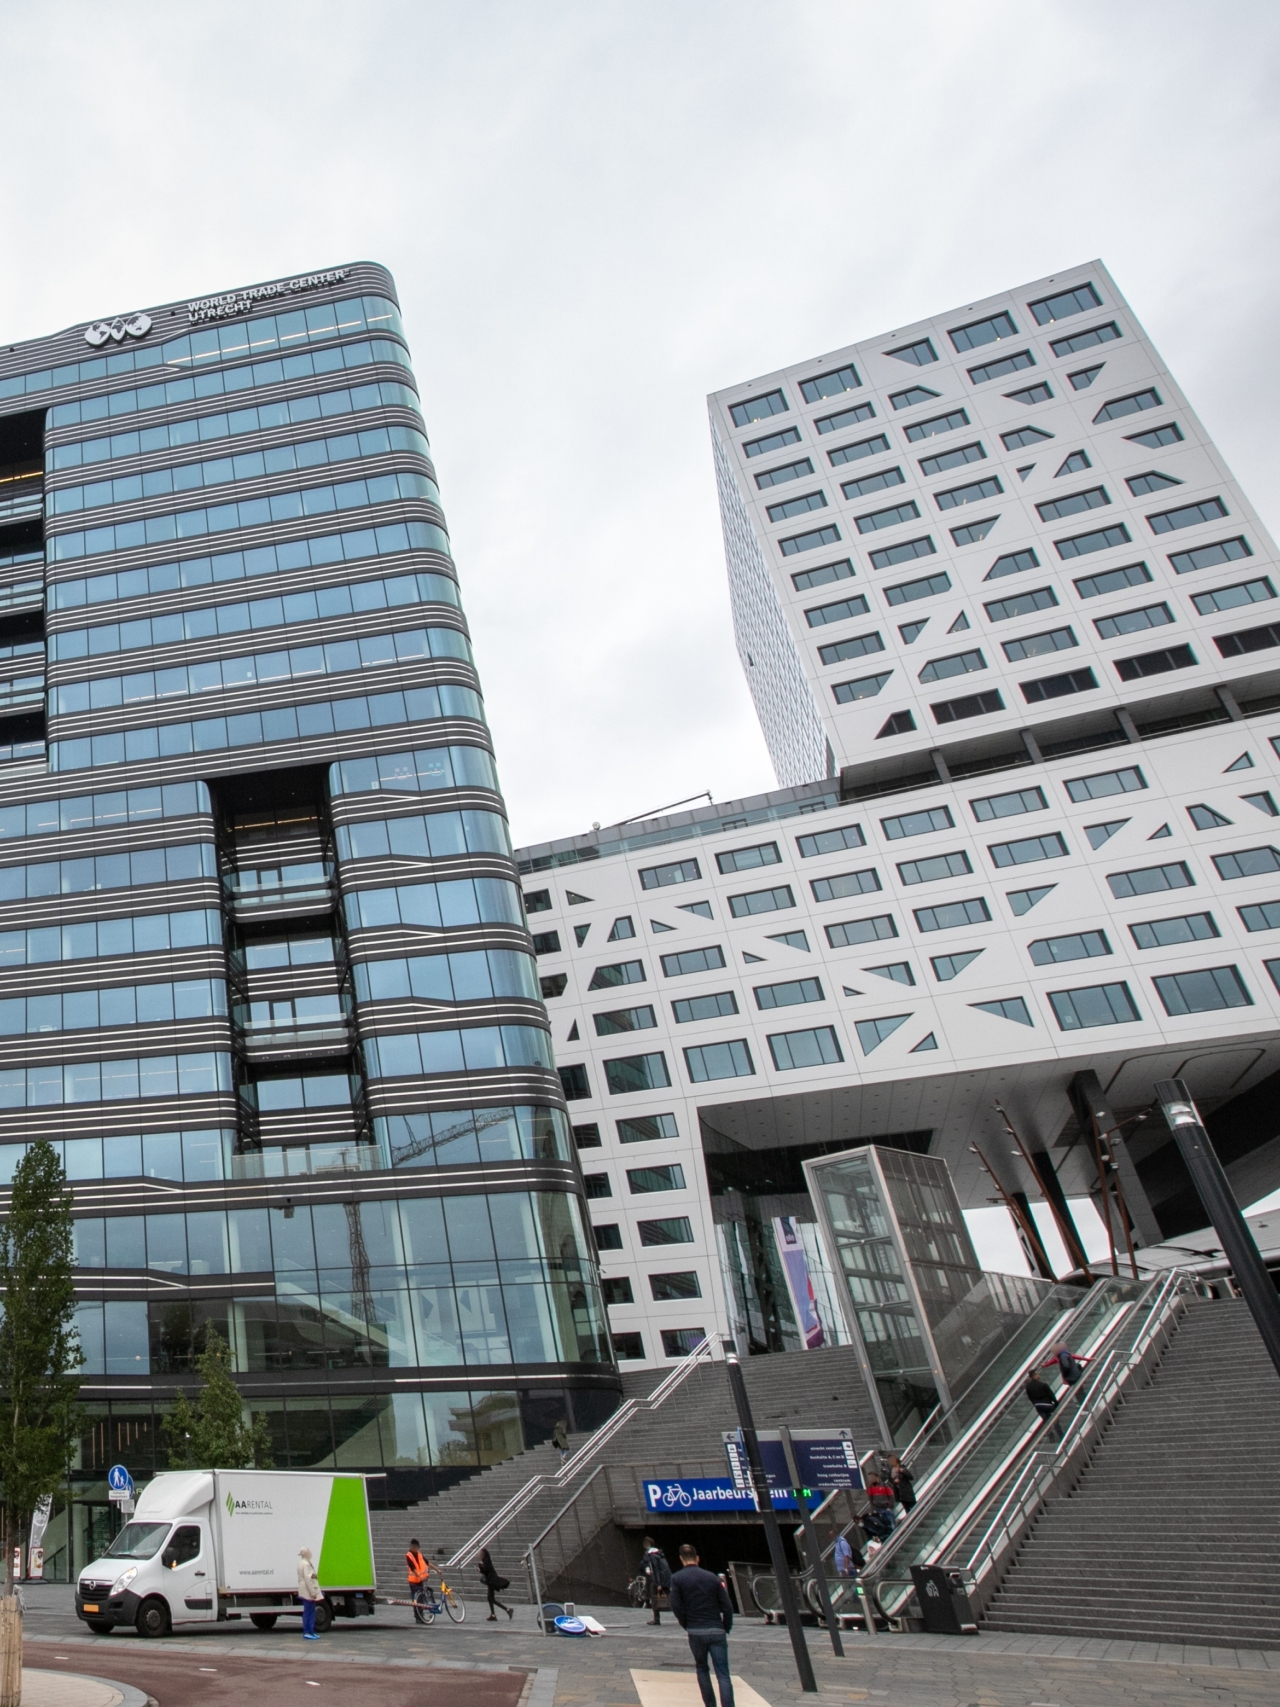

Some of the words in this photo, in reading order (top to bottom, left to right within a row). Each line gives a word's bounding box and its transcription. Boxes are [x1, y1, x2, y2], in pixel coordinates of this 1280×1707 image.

[188, 294, 236, 312] WORLD
[241, 284, 285, 299] TRADE
[289, 270, 345, 289] CENTER
[188, 301, 253, 321] UTRECHT
